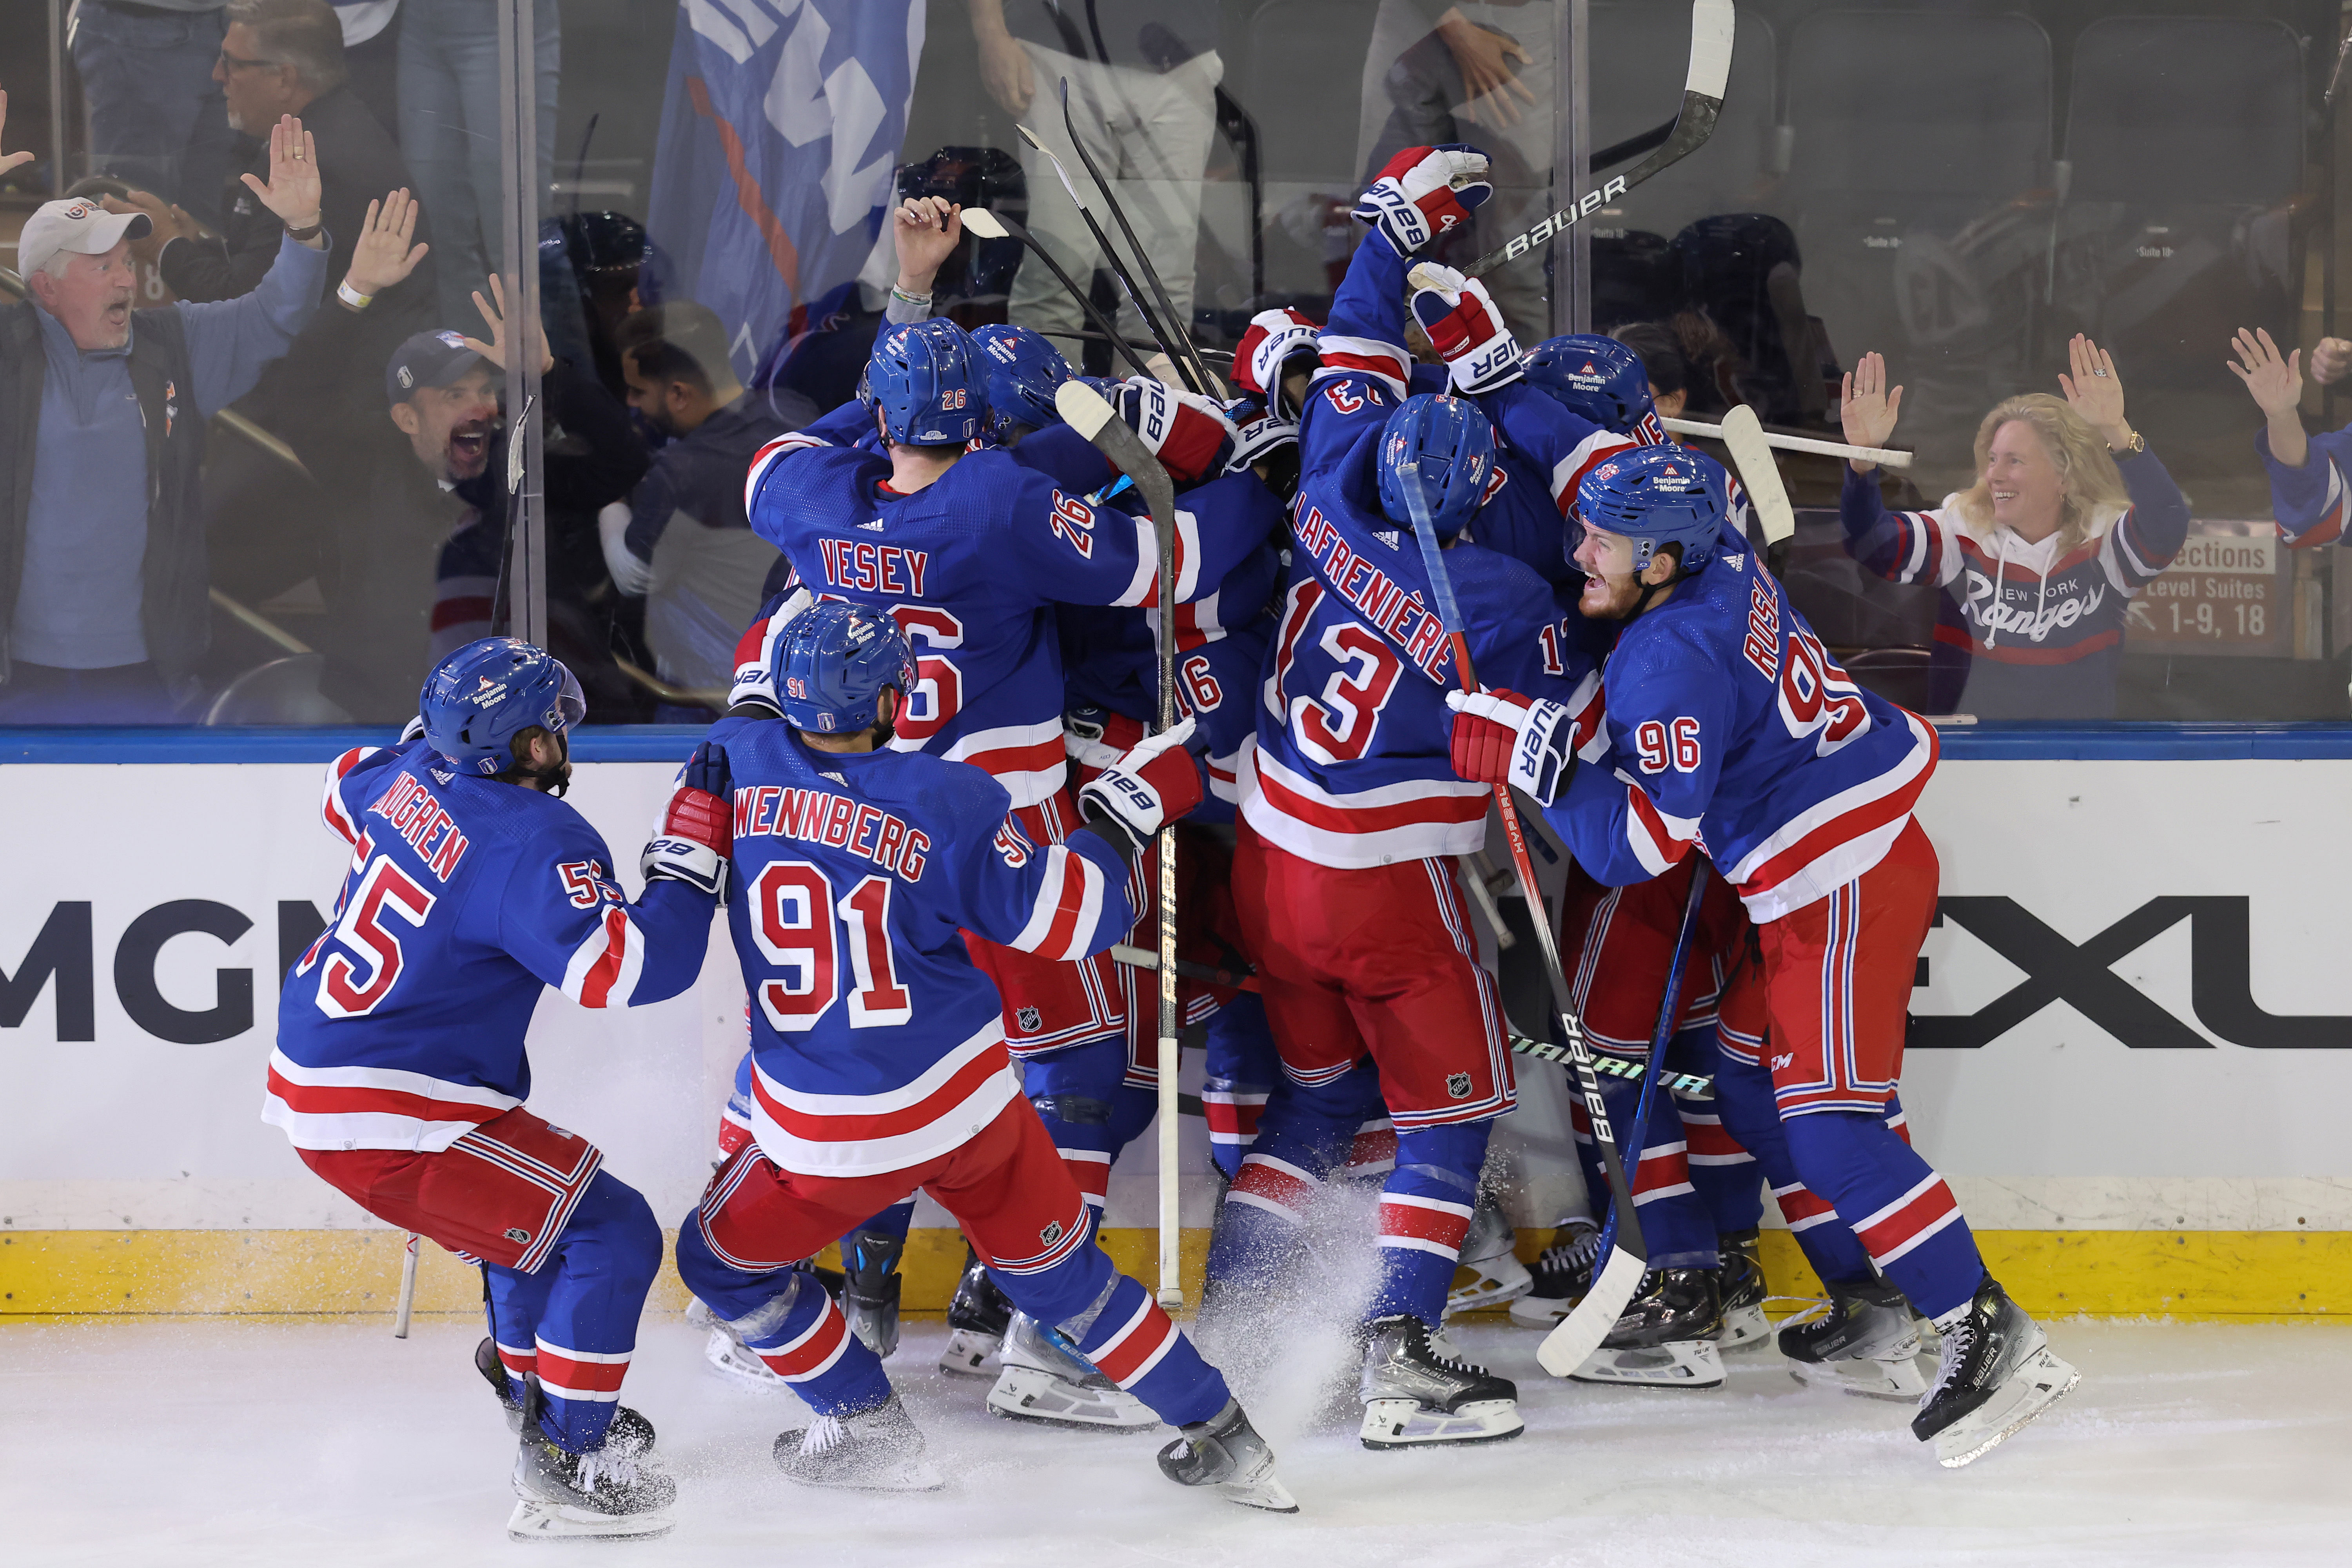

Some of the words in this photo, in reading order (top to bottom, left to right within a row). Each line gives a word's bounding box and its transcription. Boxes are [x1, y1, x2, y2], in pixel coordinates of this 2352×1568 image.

[1504, 174, 1628, 261] BAUER
[2139, 246, 2160, 257] Suite
[885, 342, 898, 356] Moore
[986, 344, 1009, 364] Moore
[989, 336, 1017, 362] Benjamin
[1568, 373, 1606, 385] Benjamin
[1573, 382, 1599, 392] Moore
[942, 388, 966, 411] 26
[1390, 431, 1399, 466] Benjamin
[1469, 454, 1484, 484] Benjamin
[1653, 476, 1690, 485] Benjamin
[857, 524, 884, 532] adidas
[1049, 488, 1096, 560] 26
[1372, 532, 1400, 551] adidas
[818, 539, 928, 597] VESEY
[1735, 553, 1745, 572] adidas
[1293, 490, 1454, 686] LAFRENIÈRE
[2146, 578, 2195, 596] Level
[2205, 579, 2265, 599] Suites
[1960, 568, 2105, 643] Rangers
[847, 622, 876, 640] Benjamin
[2170, 603, 2222, 638] 1-9,
[2235, 604, 2265, 635] 18
[856, 631, 875, 646] Moore
[817, 593, 964, 749] 6
[1263, 576, 1405, 766] 13
[472, 683, 508, 705] Benjamin
[787, 677, 807, 700] 91
[481, 693, 506, 710] Moore
[1635, 716, 1701, 774] 96
[430, 768, 446, 785] adidas
[818, 772, 849, 787] adidas
[733, 785, 931, 883] WENNBERG
[747, 860, 913, 1032] 91
[1024, 1012, 1038, 1028] NHL
[1453, 1080, 1467, 1094] NHL
[1562, 1013, 1615, 1144] BAUER
[1047, 1226, 1057, 1243] NHL
[1972, 1347, 1998, 1388] BAUER
